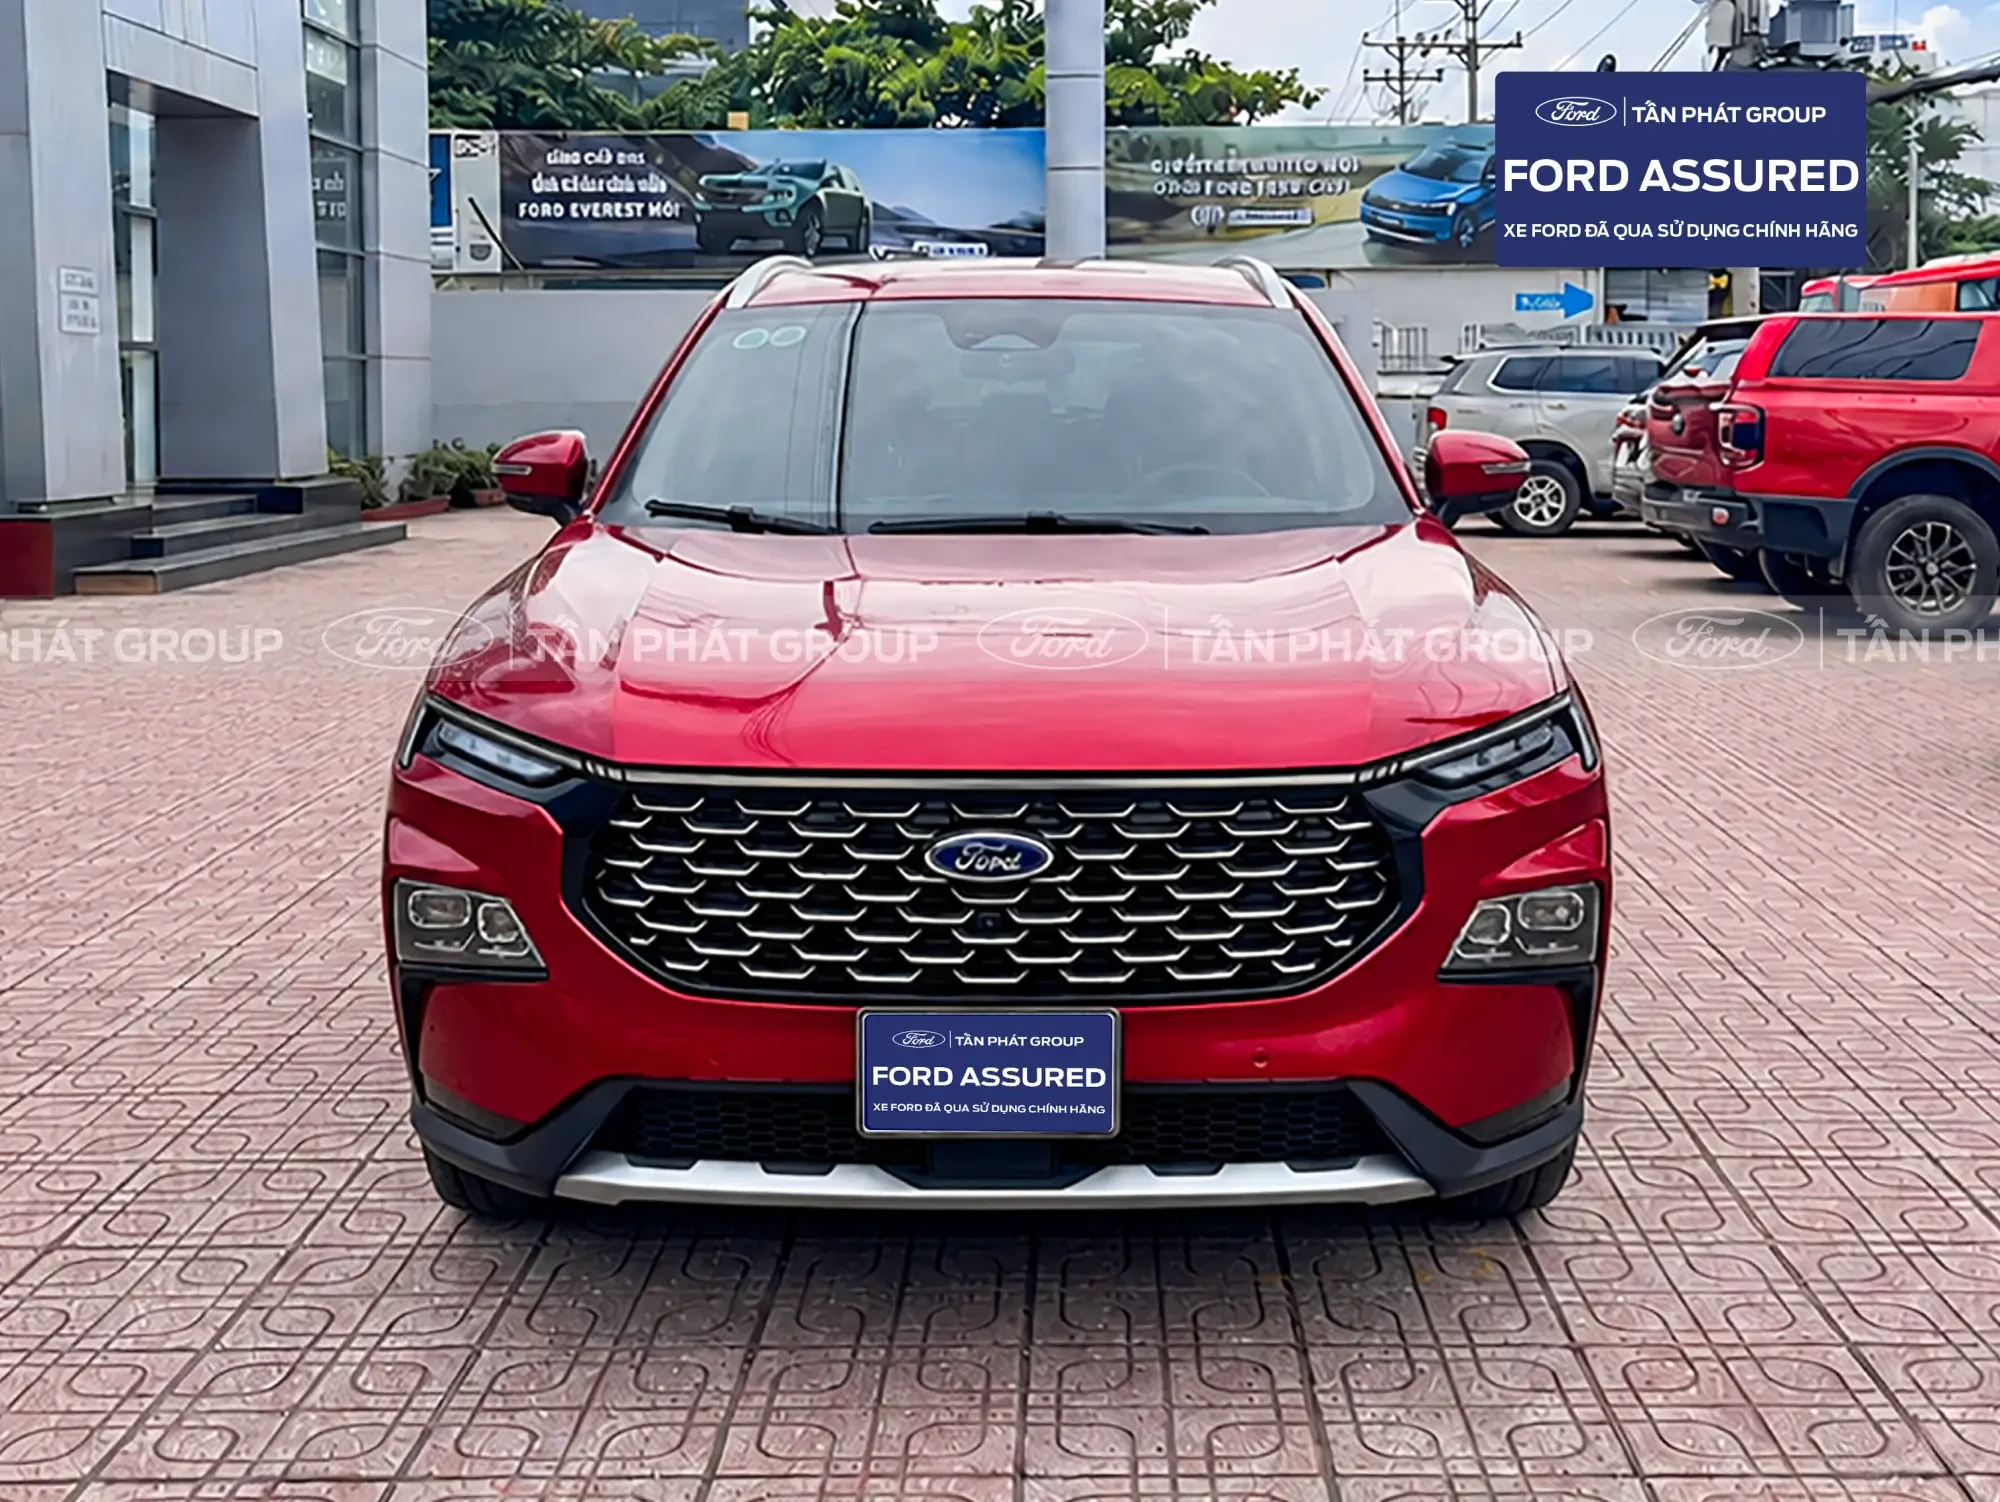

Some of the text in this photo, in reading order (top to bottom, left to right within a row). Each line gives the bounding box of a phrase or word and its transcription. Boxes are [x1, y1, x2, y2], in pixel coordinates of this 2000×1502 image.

[955, 842, 1022, 872] Ford
[902, 1032, 935, 1046] Ford
[987, 1033, 1027, 1046] PHÁT
[1030, 1036, 1085, 1047] GROUP
[872, 1066, 1107, 1088] FORD ASSURED
[873, 1103, 889, 1112] XE
[891, 1103, 923, 1112] FORD
[925, 1101, 941, 1112] ĐÃ
[943, 1103, 970, 1114] QUA
[991, 1103, 1026, 1115] DỤNG
[1028, 1102, 1067, 1114] CHÍNH
[1069, 1103, 1106, 1115] HÃNG
